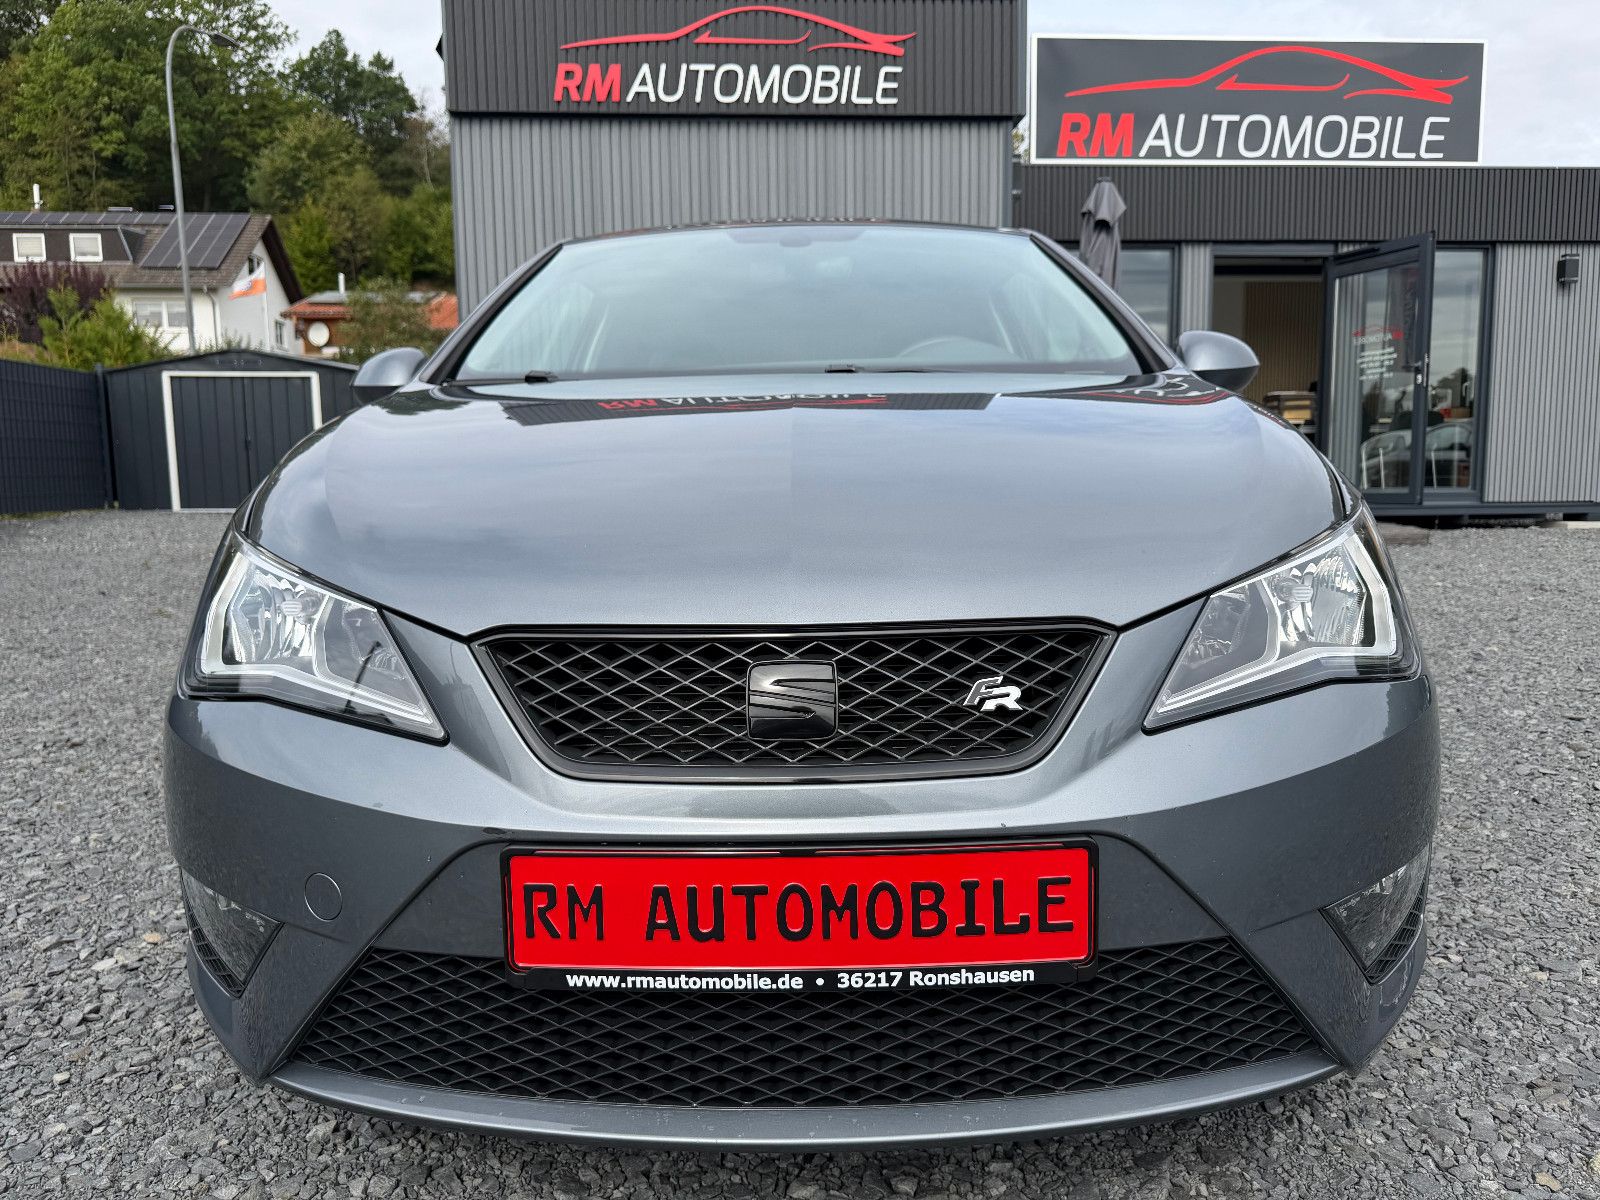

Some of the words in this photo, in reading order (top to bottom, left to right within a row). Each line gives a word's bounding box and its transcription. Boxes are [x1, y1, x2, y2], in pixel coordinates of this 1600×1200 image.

[554, 63, 621, 102] RM
[626, 63, 903, 104] AUTOMOBILE
[1057, 112, 1134, 157] RM
[1138, 113, 1451, 159] AUTOMOBILE
[963, 675, 1023, 711] FR
[524, 883, 604, 940] RM
[645, 876, 1074, 942] AUTOMOBILE
[566, 972, 804, 990] www.rmautomobile.de
[837, 970, 903, 989] 36217
[909, 968, 1035, 987] Ronshausen
